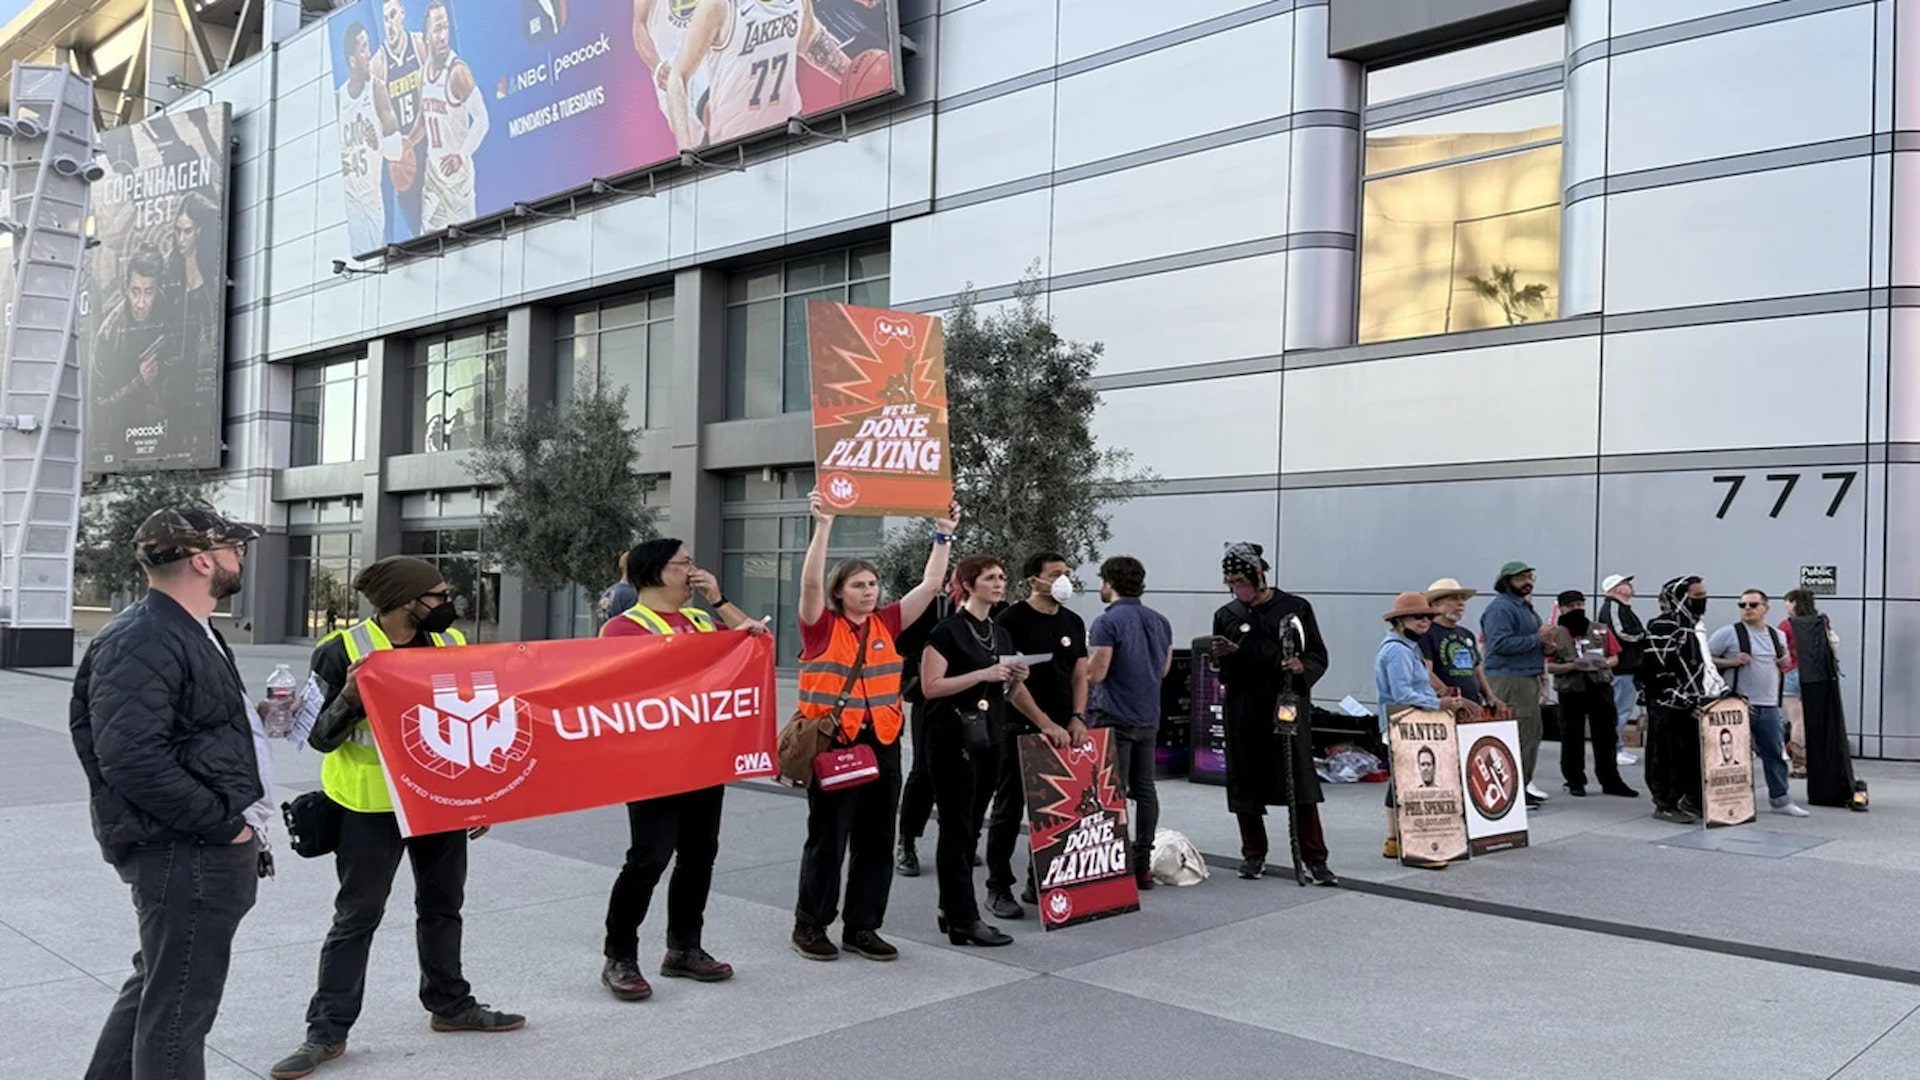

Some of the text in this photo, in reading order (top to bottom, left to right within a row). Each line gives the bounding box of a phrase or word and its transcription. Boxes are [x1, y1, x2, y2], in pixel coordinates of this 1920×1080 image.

[738, 10, 799, 57] LAKERS
[517, 32, 611, 91] NBC peacock
[749, 53, 788, 110] 77
[399, 94, 414, 127] 15
[508, 86, 605, 139] MONDAYS & TUESDAYS
[428, 117, 443, 149] 11
[104, 157, 212, 205] COPENHAGEN
[135, 195, 175, 229] TEST
[881, 403, 918, 416] WE'RE
[126, 422, 164, 442] peacock
[855, 417, 930, 438] DONE
[822, 440, 941, 471] PLAYING
[1802, 567, 1833, 576] Public
[552, 687, 761, 740] UNIONIZE!
[1709, 710, 1743, 726] WANTED
[1399, 722, 1448, 740] WANTED
[734, 752, 773, 773] CWA
[400, 774, 429, 798] UNITED
[430, 794, 483, 806] VIDEOGAME
[1423, 800, 1457, 815] SPENCER
[1063, 821, 1115, 853] DONE
[1041, 840, 1126, 885] PLAYING
